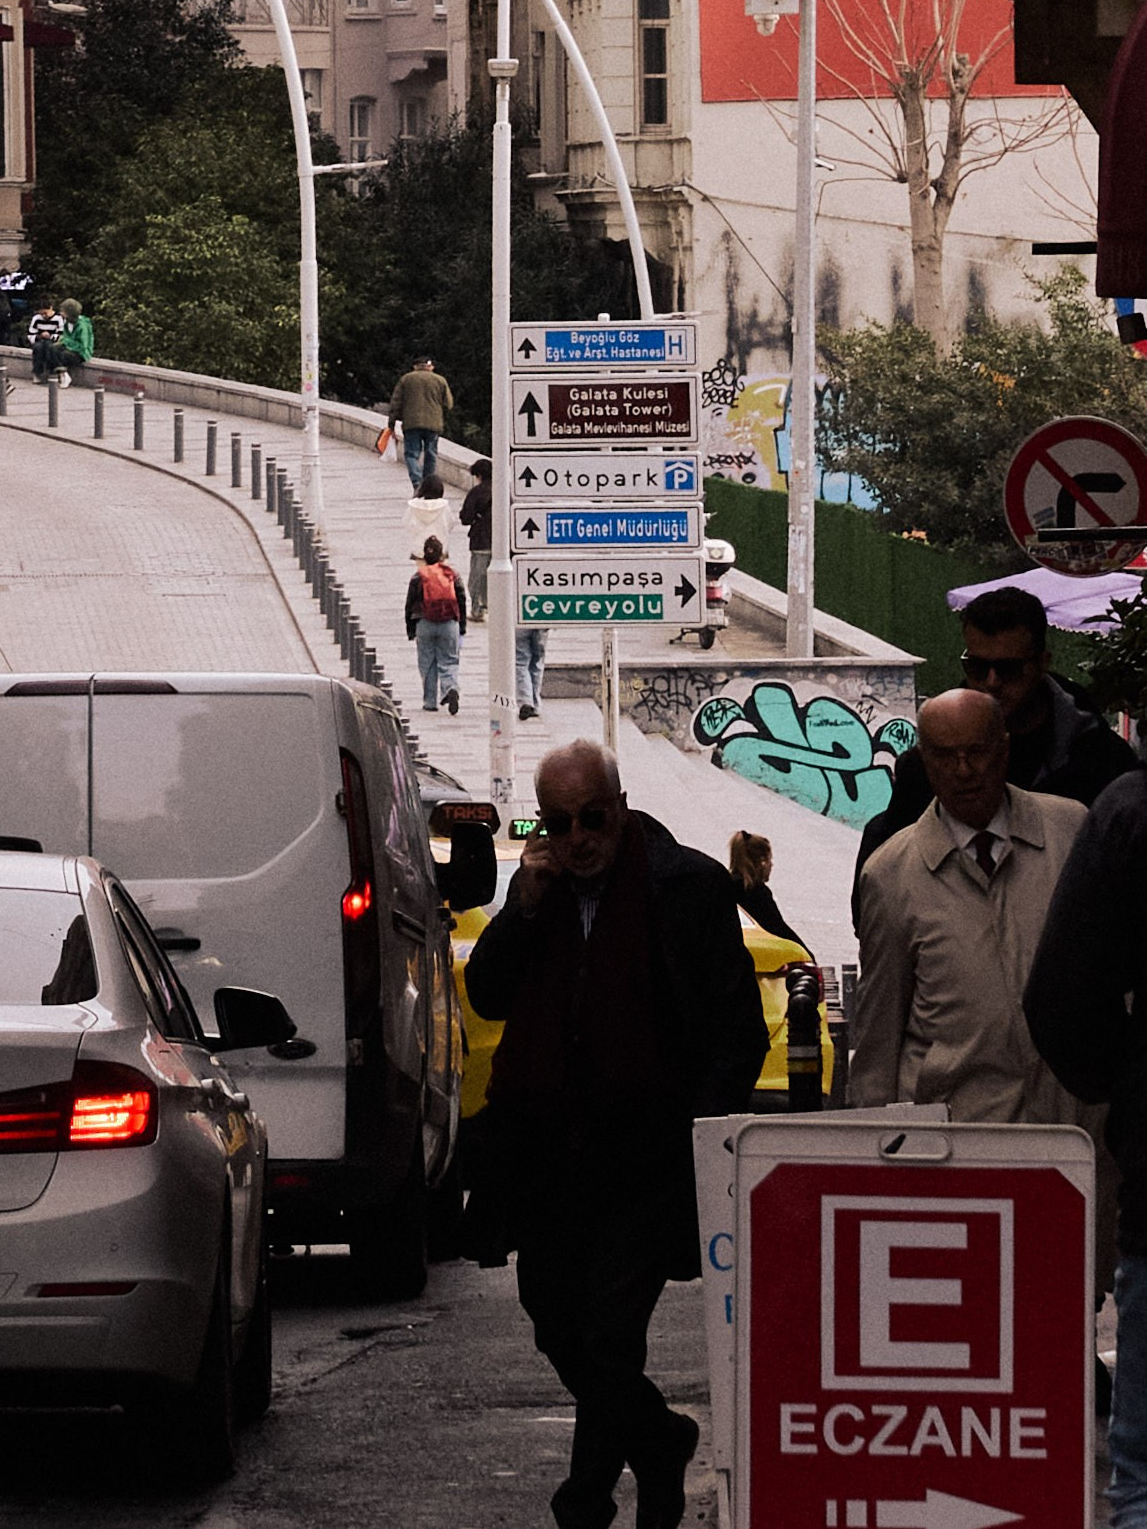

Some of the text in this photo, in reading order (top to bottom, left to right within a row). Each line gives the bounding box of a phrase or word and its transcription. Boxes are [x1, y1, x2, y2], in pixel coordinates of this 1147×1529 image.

[570, 331, 640, 346] Beyoğlu Göz
[669, 334, 683, 356] H
[546, 346, 665, 362] Eğt. ve Arşt. Hastanesi
[569, 387, 669, 401] Galata Kulesi
[567, 402, 673, 419] (Galata Tower)
[550, 420, 690, 435] Galata Mevlevihanesi Müzesi
[544, 468, 658, 492] Otopark
[547, 514, 687, 541] İETT Genel Müdürlüğü
[527, 567, 664, 591] Kasımpaşa
[524, 595, 662, 619] Çevreyolu
[860, 1220, 970, 1369] E
[780, 1403, 1047, 1459] ECZANE
